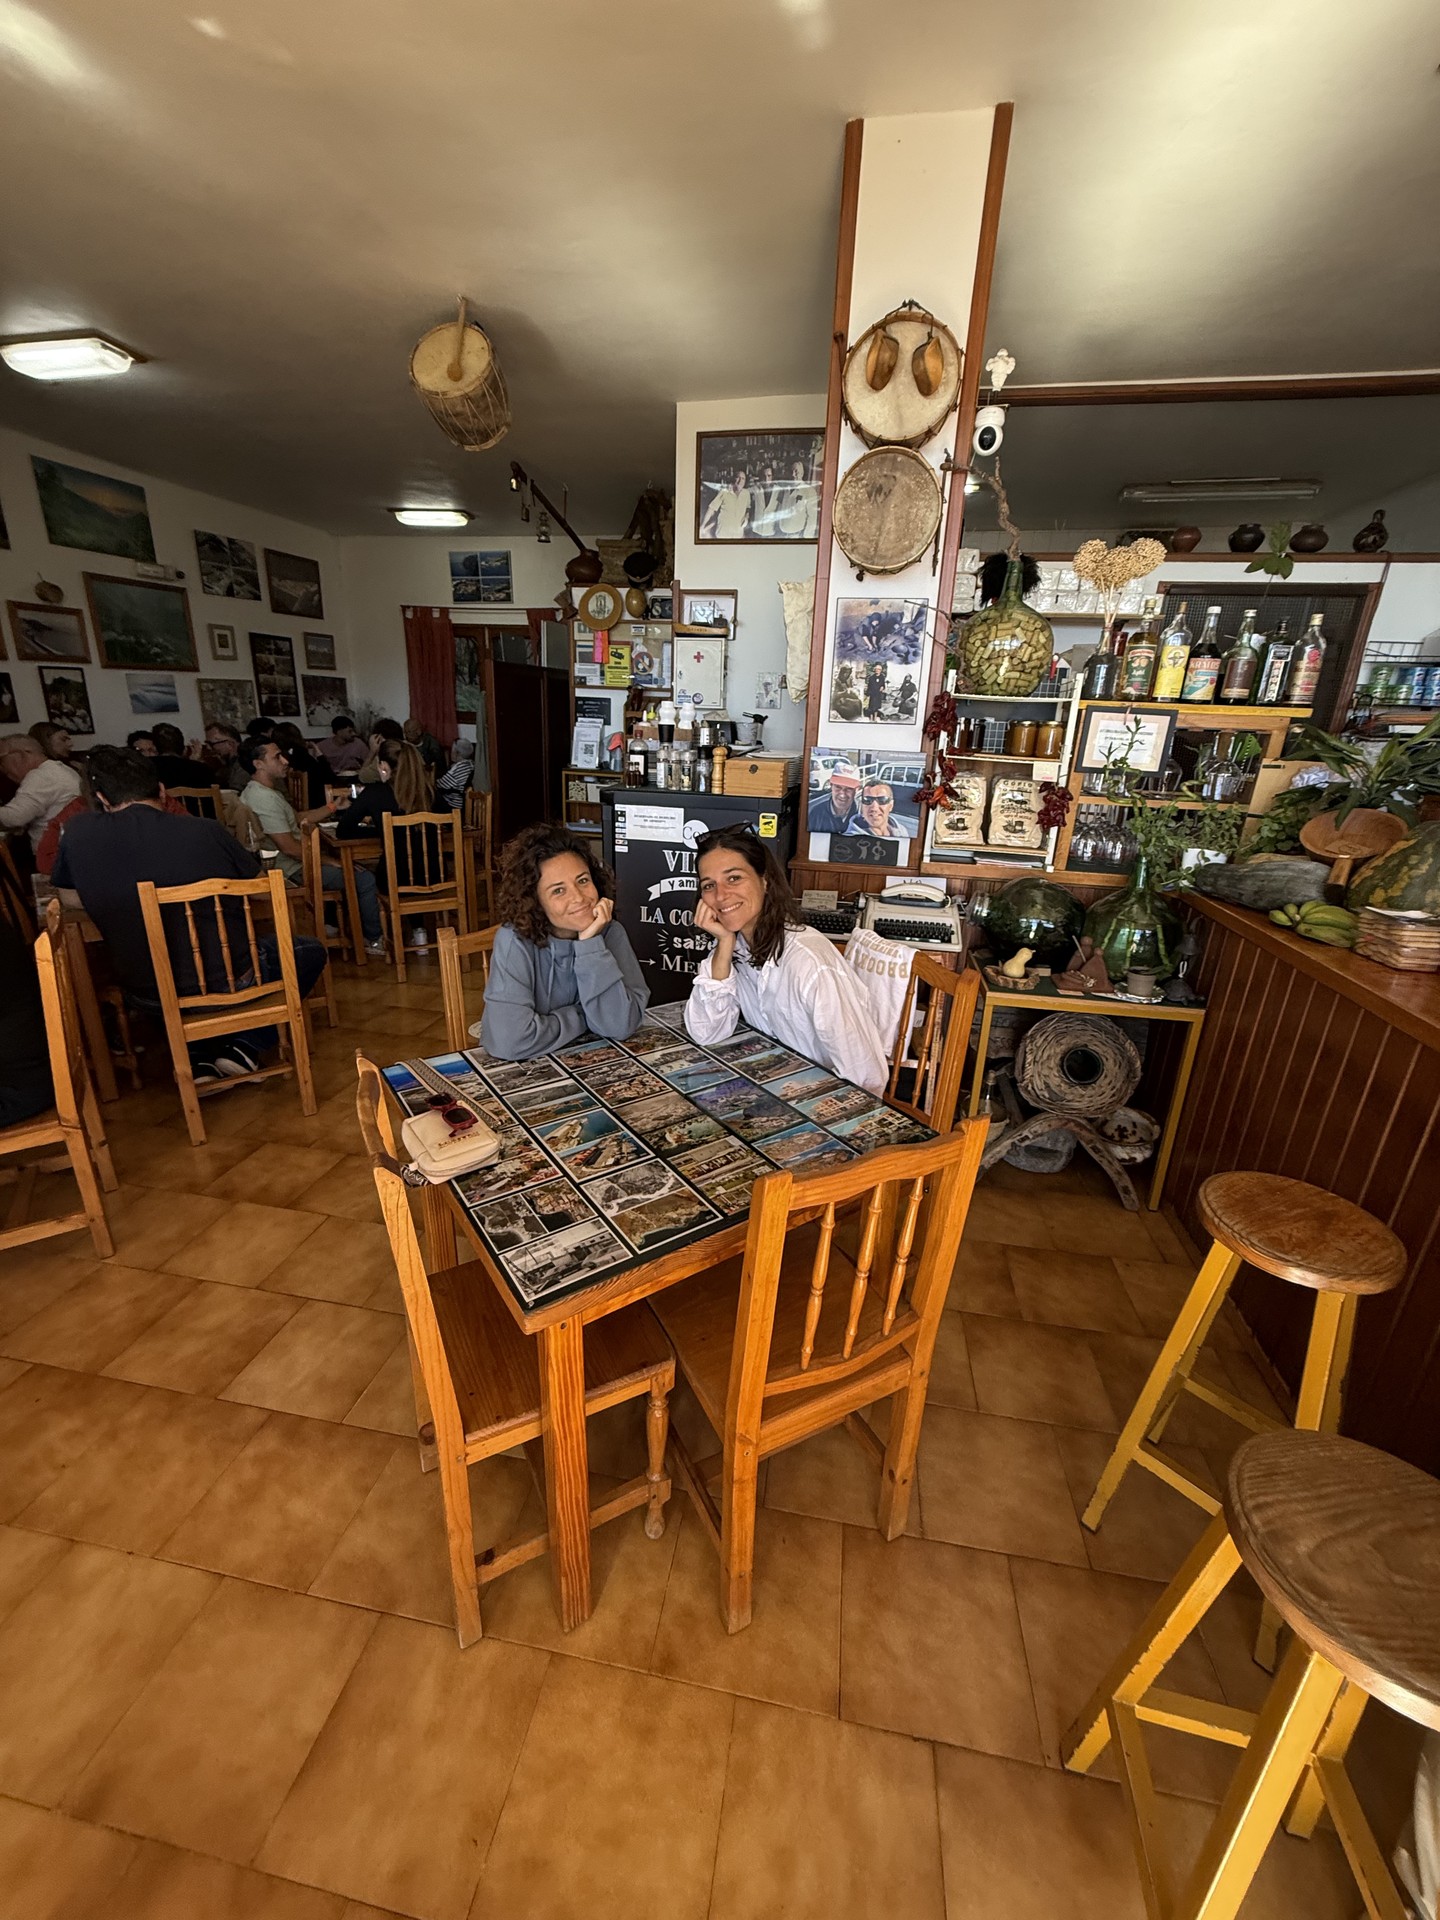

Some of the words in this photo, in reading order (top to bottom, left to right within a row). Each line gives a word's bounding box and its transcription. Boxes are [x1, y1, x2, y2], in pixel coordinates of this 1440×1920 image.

[682, 826, 702, 840] Co
[678, 879, 700, 888] ami
[639, 905, 666, 924] LA
[669, 908, 697, 927] CO
[844, 944, 910, 979] BROOKLY
